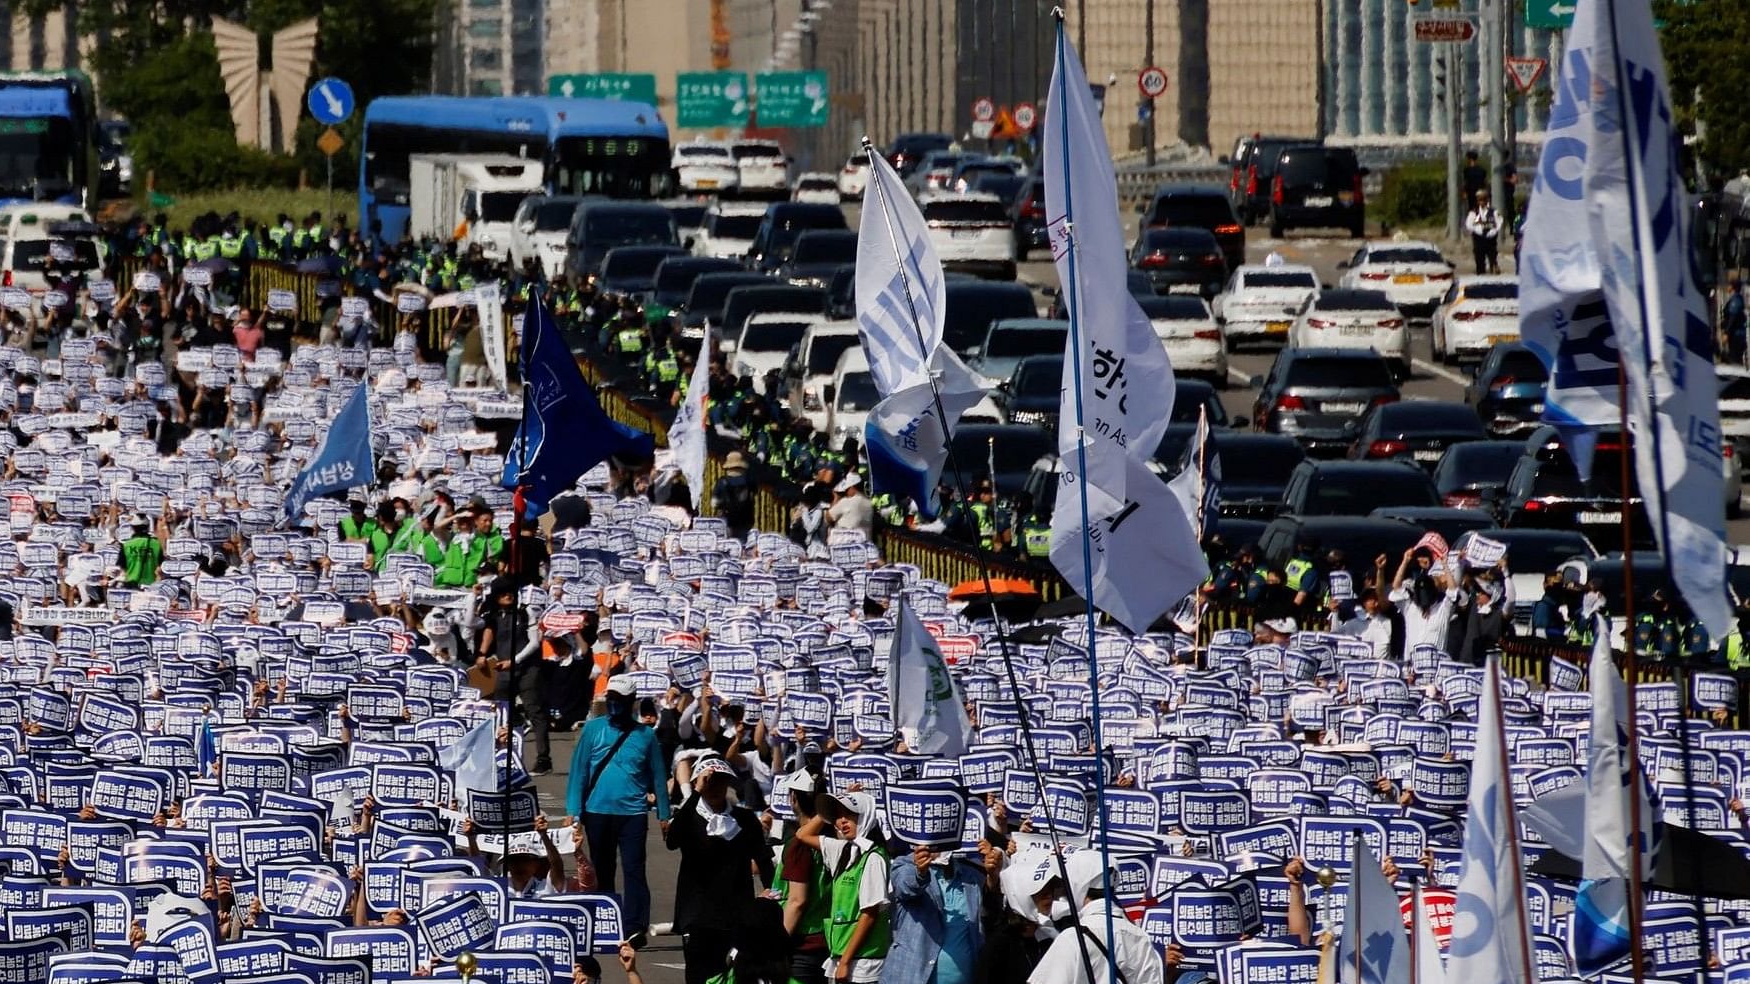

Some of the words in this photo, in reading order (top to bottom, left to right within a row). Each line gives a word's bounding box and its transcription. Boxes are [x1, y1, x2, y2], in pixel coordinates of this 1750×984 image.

[891, 799, 922, 815] 의료농단
[924, 802, 959, 817] 교육농단
[893, 814, 922, 833] 필수의료
[924, 816, 959, 834] 붕괴된다
[1306, 829, 1342, 846] 의료농단
[1178, 904, 1211, 919] 의료농단
[1214, 905, 1238, 920] 교육농단
[1249, 965, 1287, 982] 의료농단
